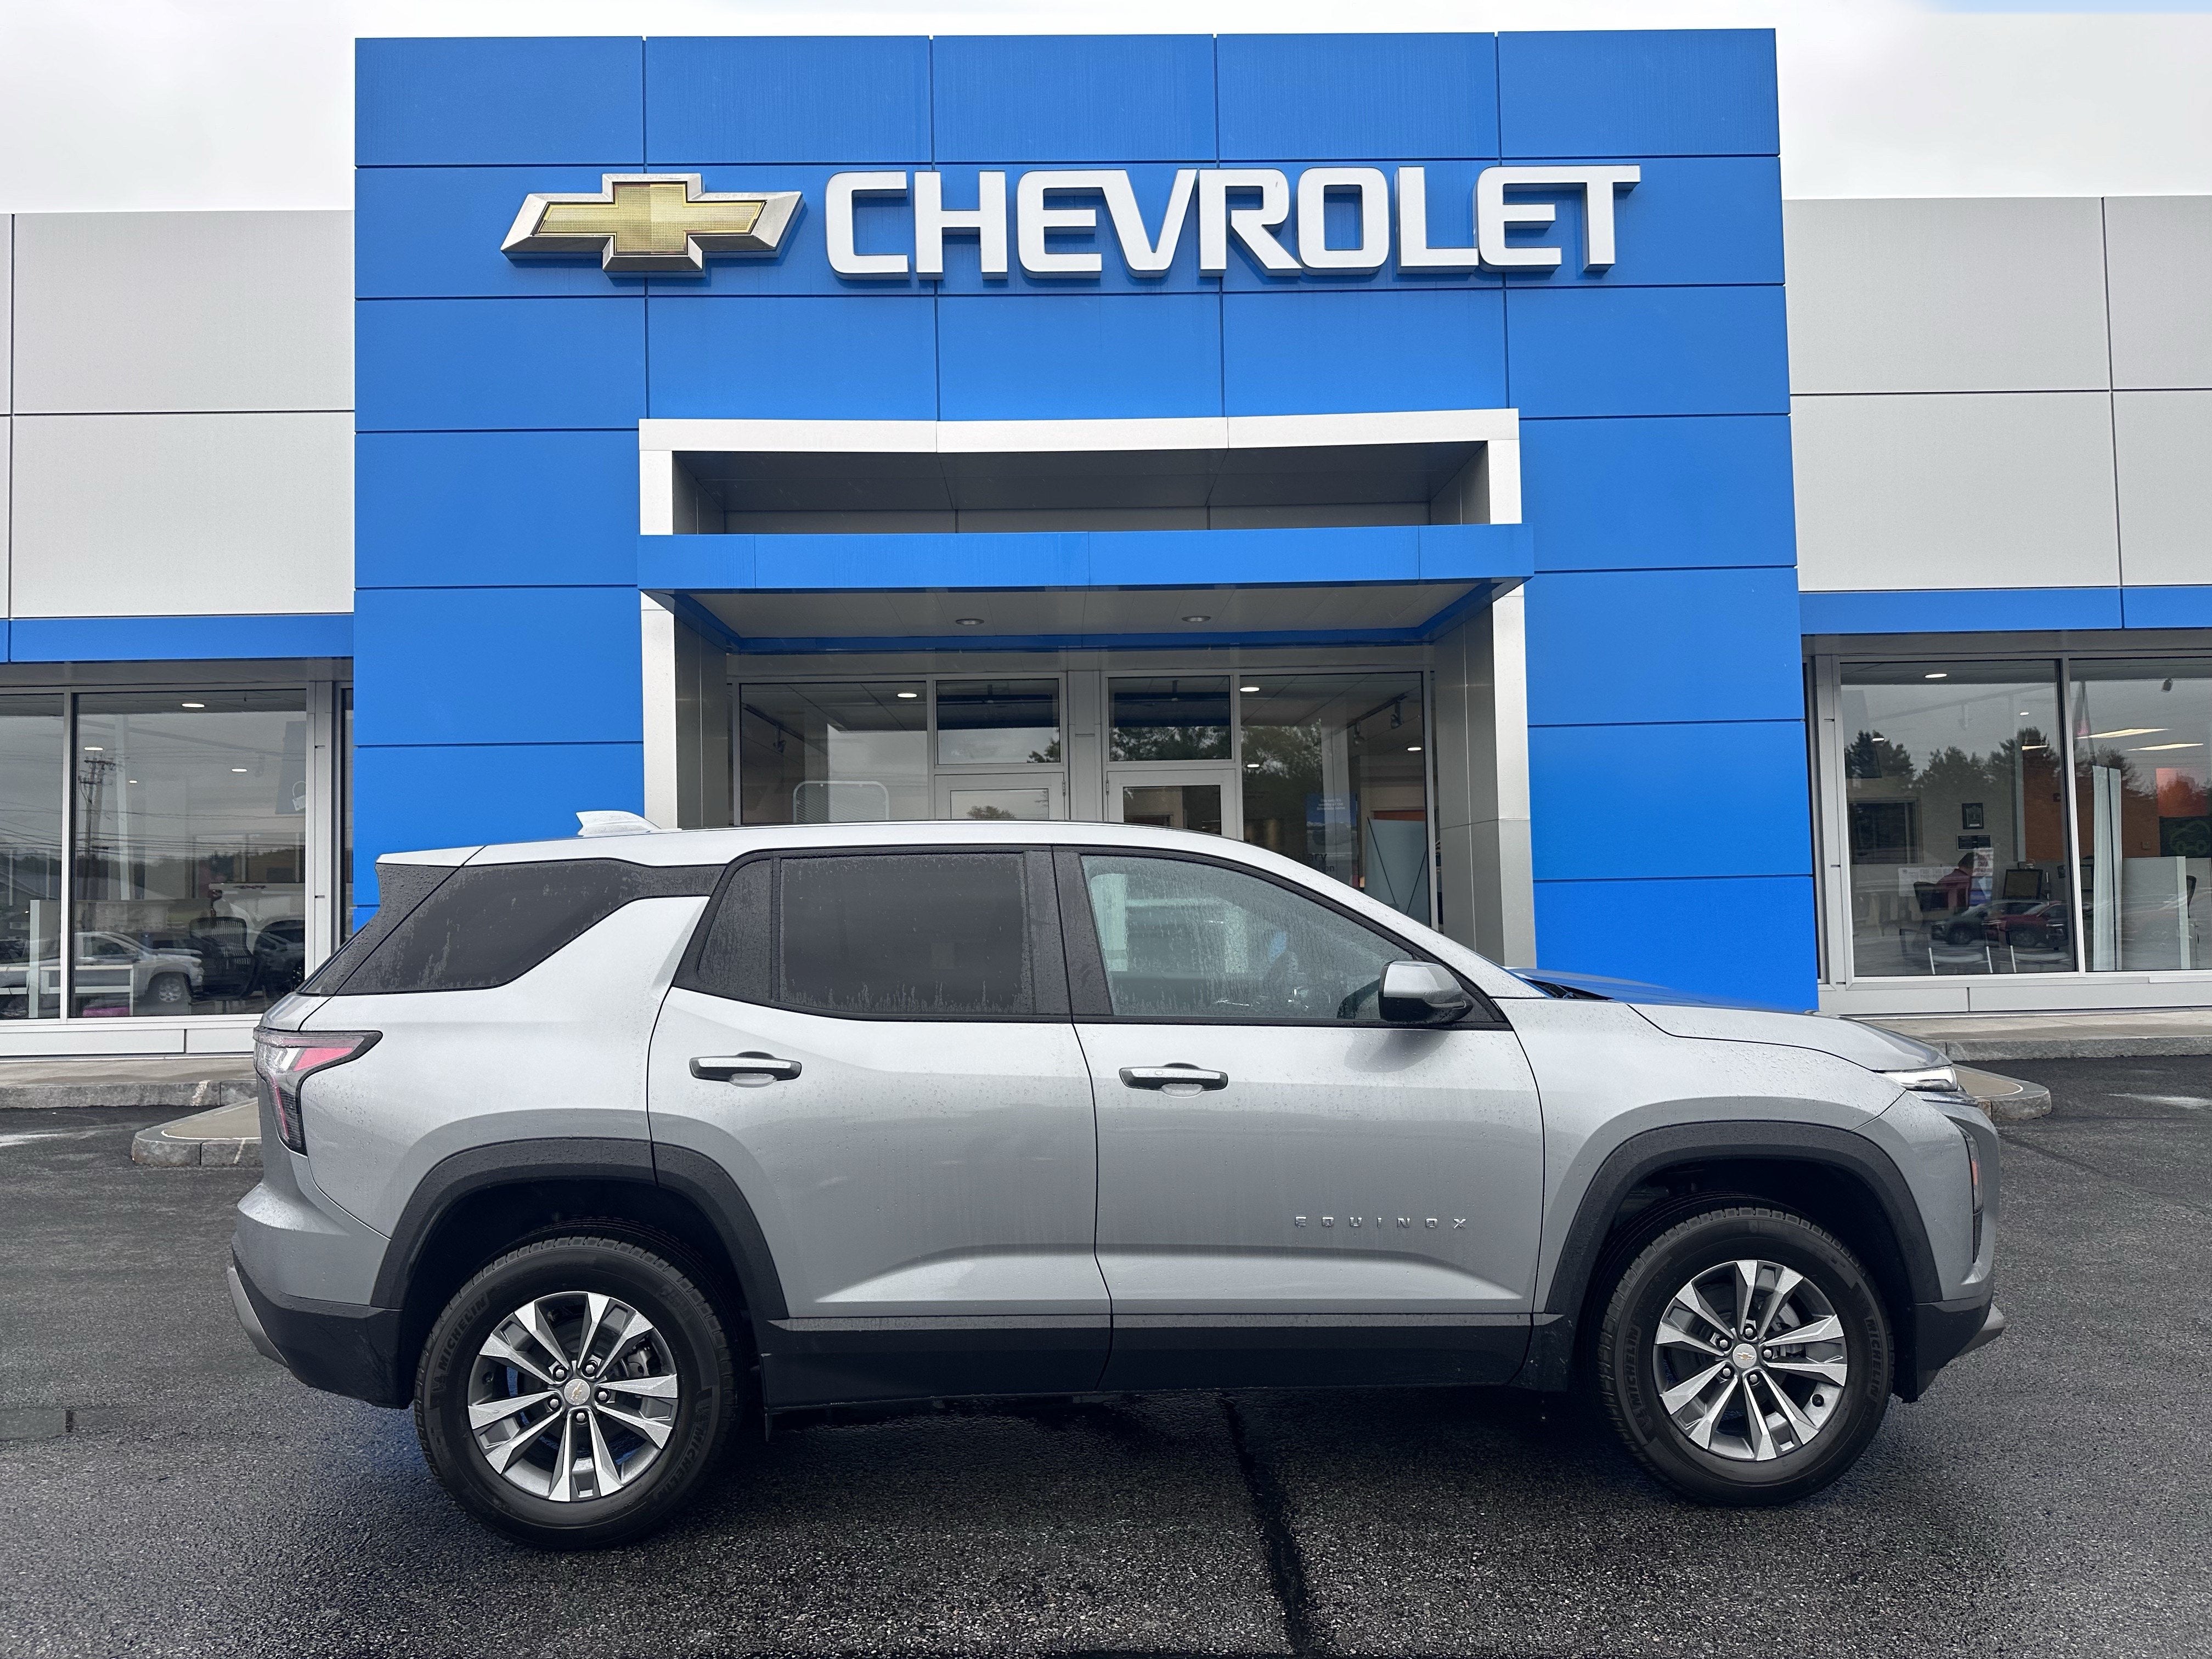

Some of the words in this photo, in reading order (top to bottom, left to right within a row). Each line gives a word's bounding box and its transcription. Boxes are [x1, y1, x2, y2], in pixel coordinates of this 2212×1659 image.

[825, 165, 1641, 279] CHEVROLET
[1295, 1216, 1466, 1229] EQUINOX
[439, 1297, 487, 1370] MICHELIN
[1625, 1327, 1642, 1406] MICHELIN
[1866, 1319, 1881, 1397] MICHELIN
